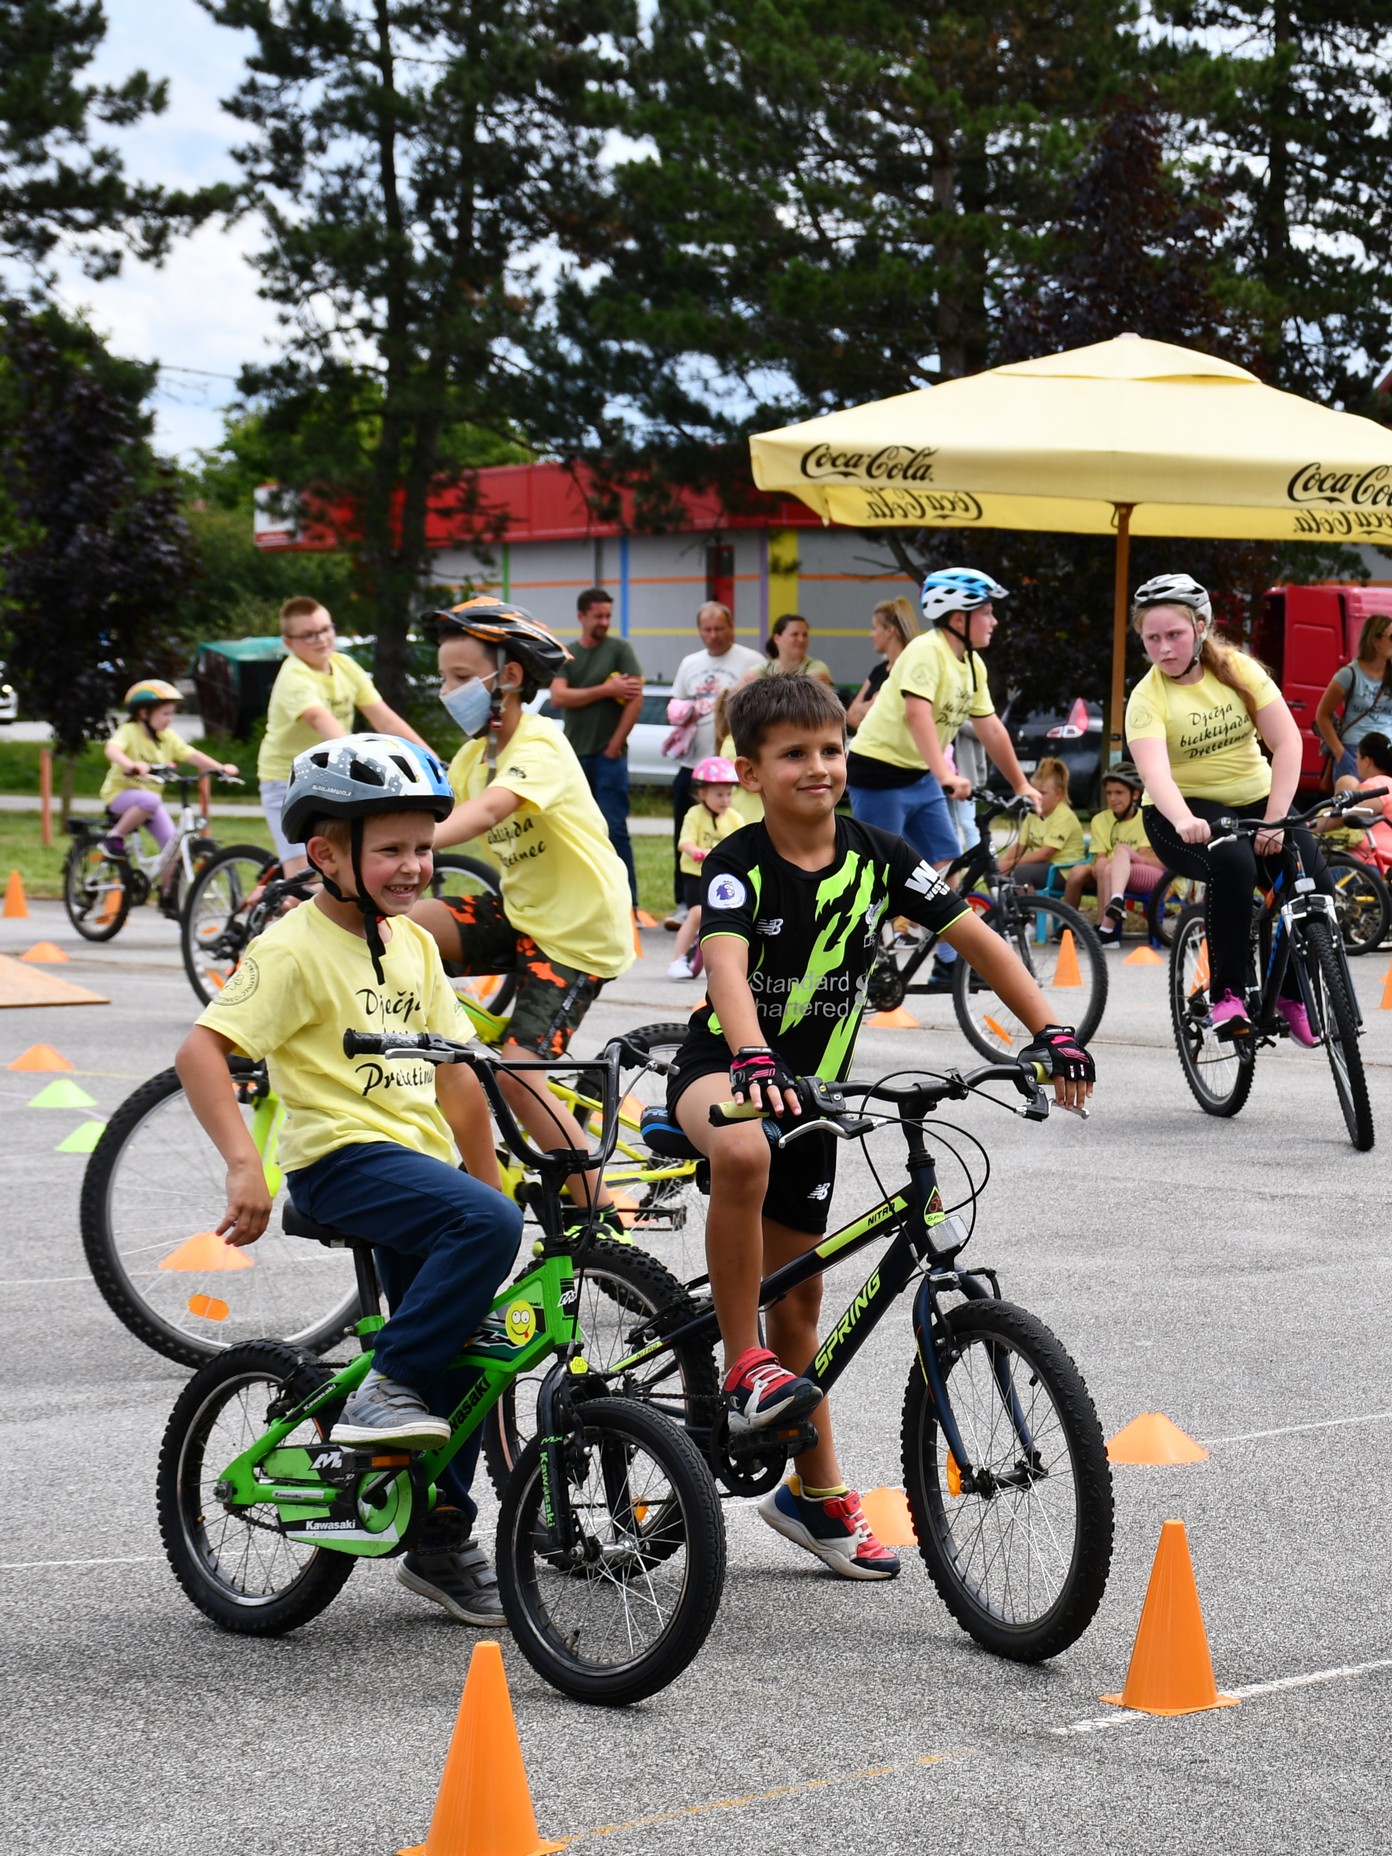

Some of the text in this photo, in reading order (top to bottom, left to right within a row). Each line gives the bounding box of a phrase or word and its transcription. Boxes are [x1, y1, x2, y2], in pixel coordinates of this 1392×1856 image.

[801, 443, 939, 482] Coca-Cola
[1187, 704, 1232, 727] Dječja
[1180, 714, 1250, 748] biciklijada
[750, 970, 850, 994] Standard
[755, 998, 850, 1018] hartered
[815, 1267, 881, 1378] SPRING
[540, 1452, 556, 1529] Kawasaki
[306, 1519, 356, 1531] Kawasaki
